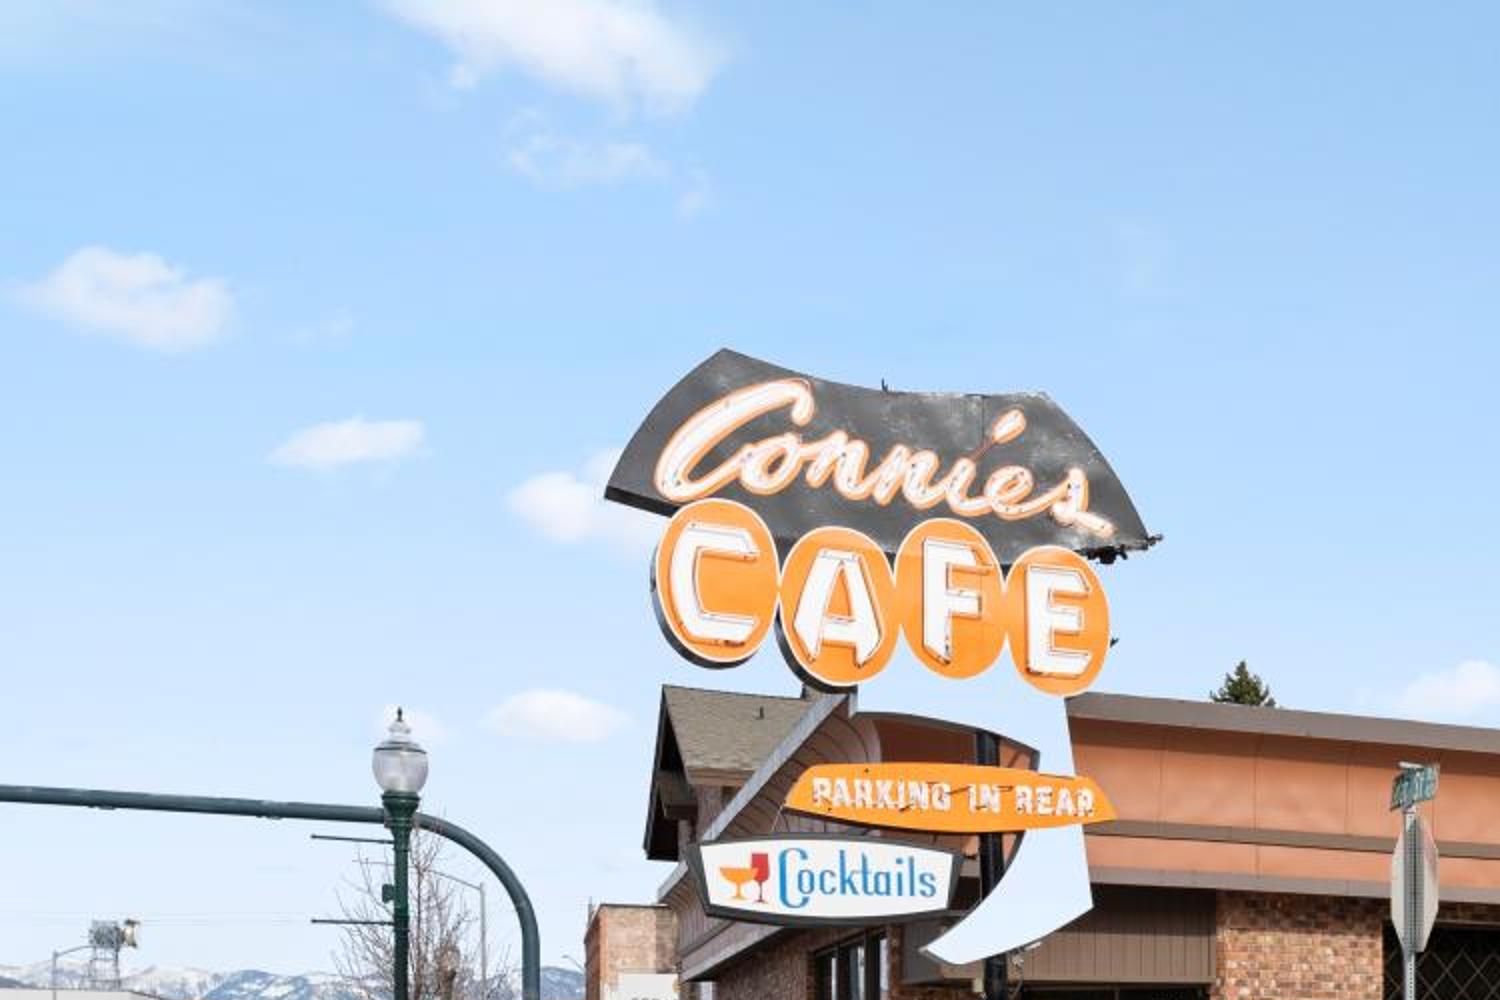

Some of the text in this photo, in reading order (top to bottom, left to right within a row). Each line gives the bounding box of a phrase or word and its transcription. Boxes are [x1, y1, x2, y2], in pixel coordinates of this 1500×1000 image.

[668, 521, 1092, 678] CAFE
[811, 777, 1096, 818] PARKING IN REAR
[778, 847, 937, 909] Cocktails
